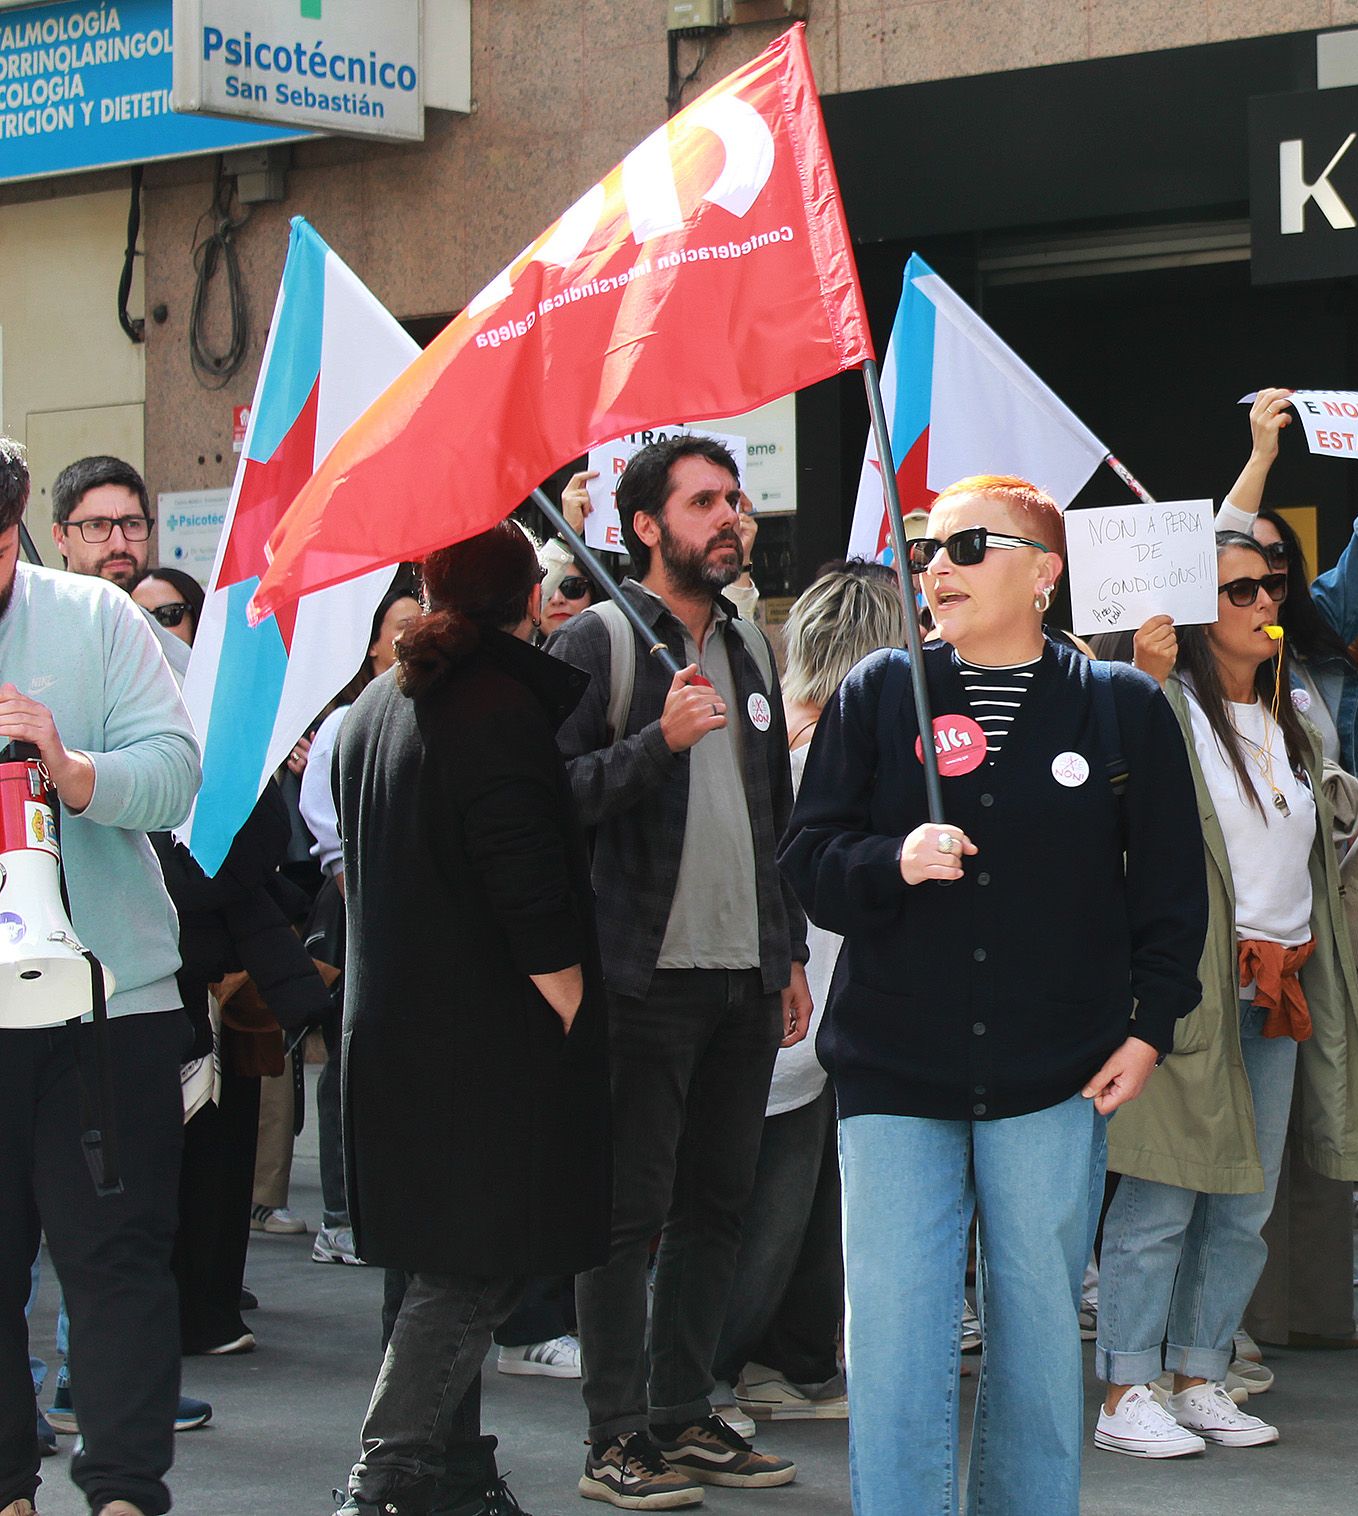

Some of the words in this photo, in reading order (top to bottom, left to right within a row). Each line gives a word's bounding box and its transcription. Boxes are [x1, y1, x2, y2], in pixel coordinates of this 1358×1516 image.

[0, 2, 121, 50] ALMOLOGÍA
[203, 26, 417, 91] Psicotécnico
[80, 101, 95, 126] Y
[101, 89, 174, 124] DIETETI
[225, 76, 268, 102] San
[275, 83, 385, 119] Sebastián
[1303, 401, 1321, 415] E
[1087, 515, 1137, 547] NON
[1161, 510, 1203, 535] PERDA
[1129, 541, 1164, 563] DE
